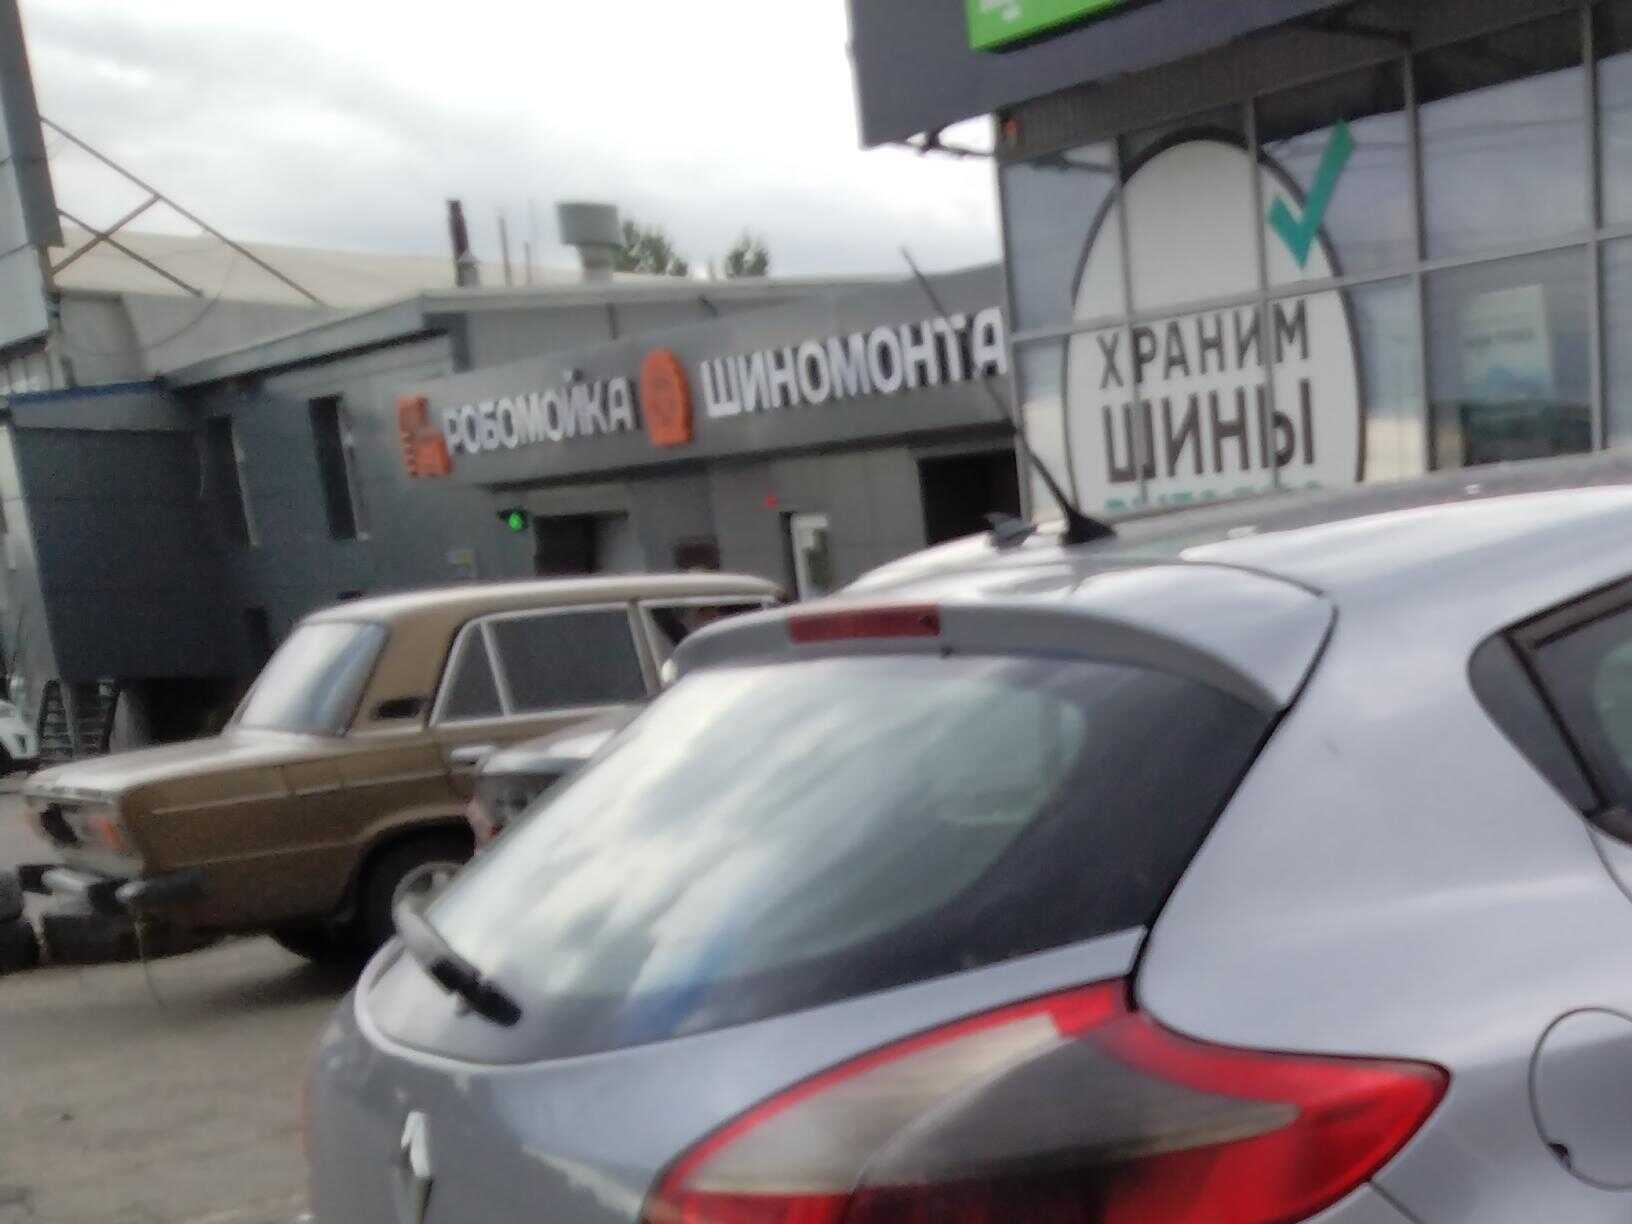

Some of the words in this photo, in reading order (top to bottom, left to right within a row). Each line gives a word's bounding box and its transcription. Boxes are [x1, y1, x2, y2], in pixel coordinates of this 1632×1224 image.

[1096, 300, 1309, 390] ХРАНИМ
[442, 370, 641, 455] РОБОМОЙКА
[1102, 377, 1315, 484] ШИНЫ
